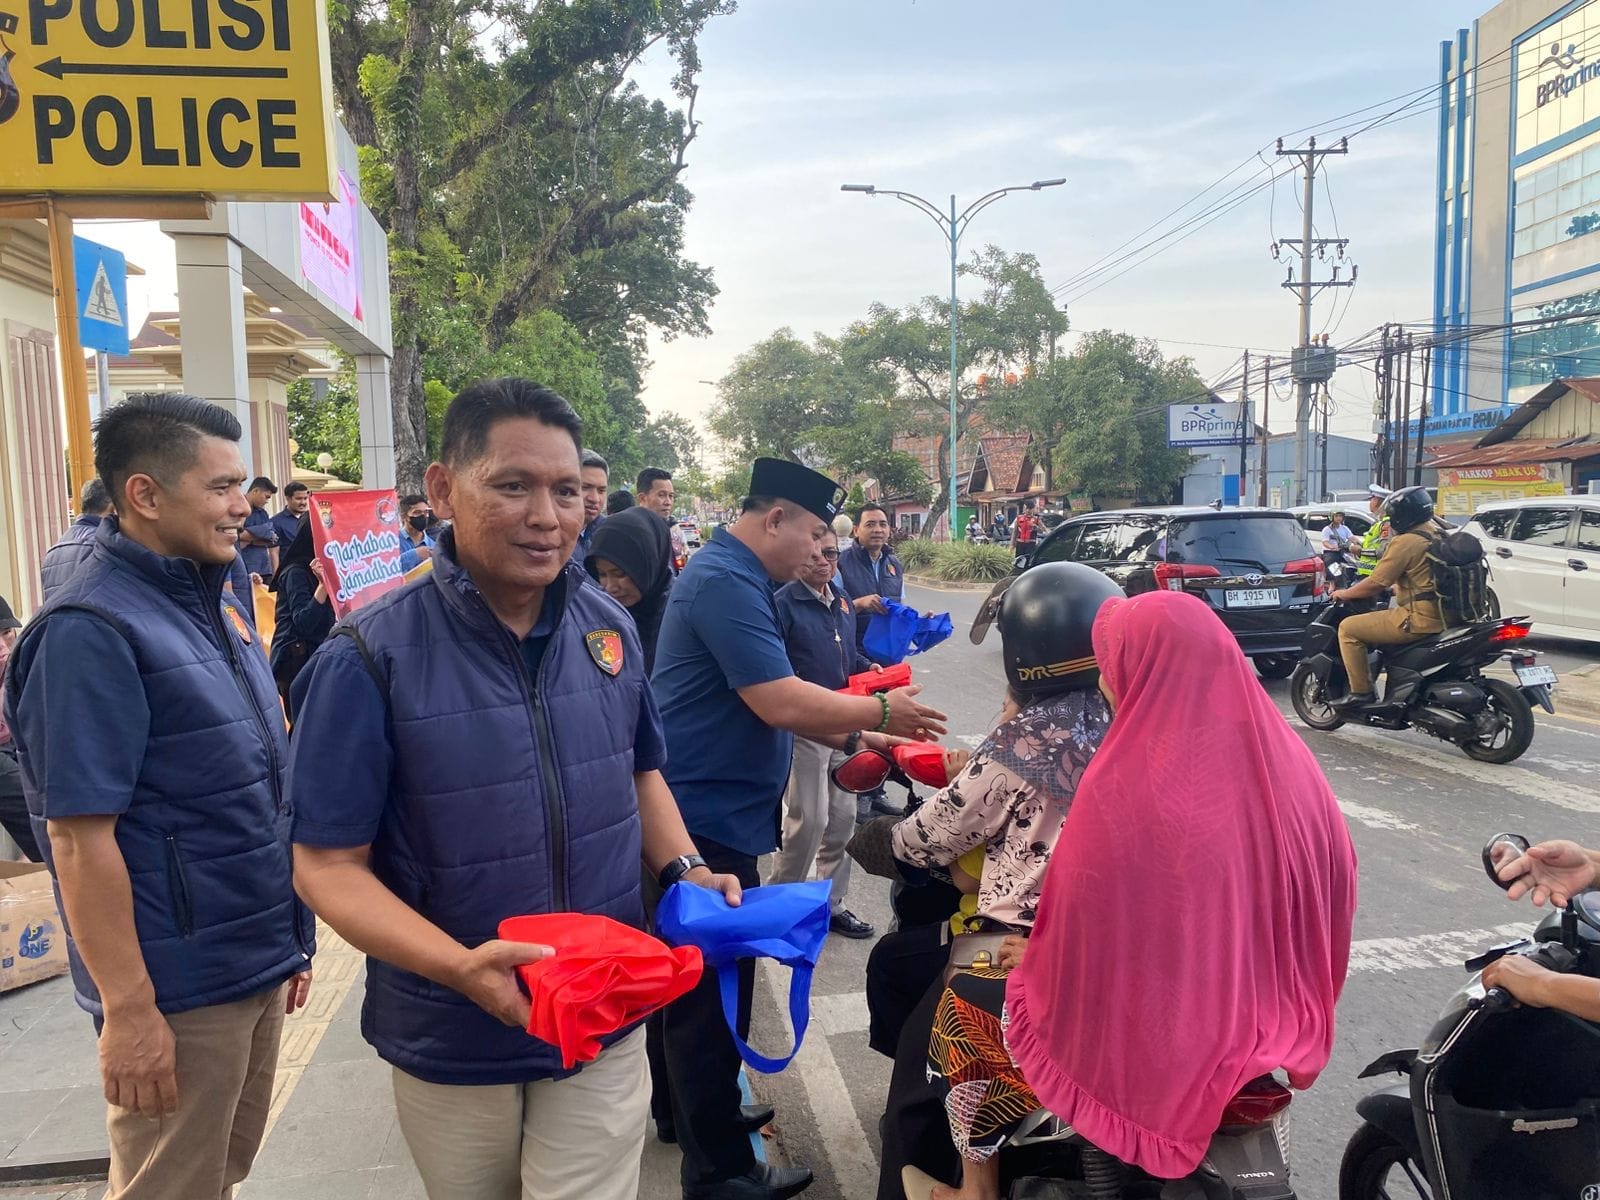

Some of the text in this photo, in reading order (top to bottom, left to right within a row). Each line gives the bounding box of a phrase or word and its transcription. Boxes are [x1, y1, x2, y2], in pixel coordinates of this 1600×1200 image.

[28, 0, 292, 51] POLISI
[32, 94, 301, 168] POLICE
[1457, 466, 1538, 480] WARKOP MBAK US
[1228, 591, 1239, 601] BH
[1243, 590, 1264, 601] 1915
[1017, 666, 1052, 680] DYR
